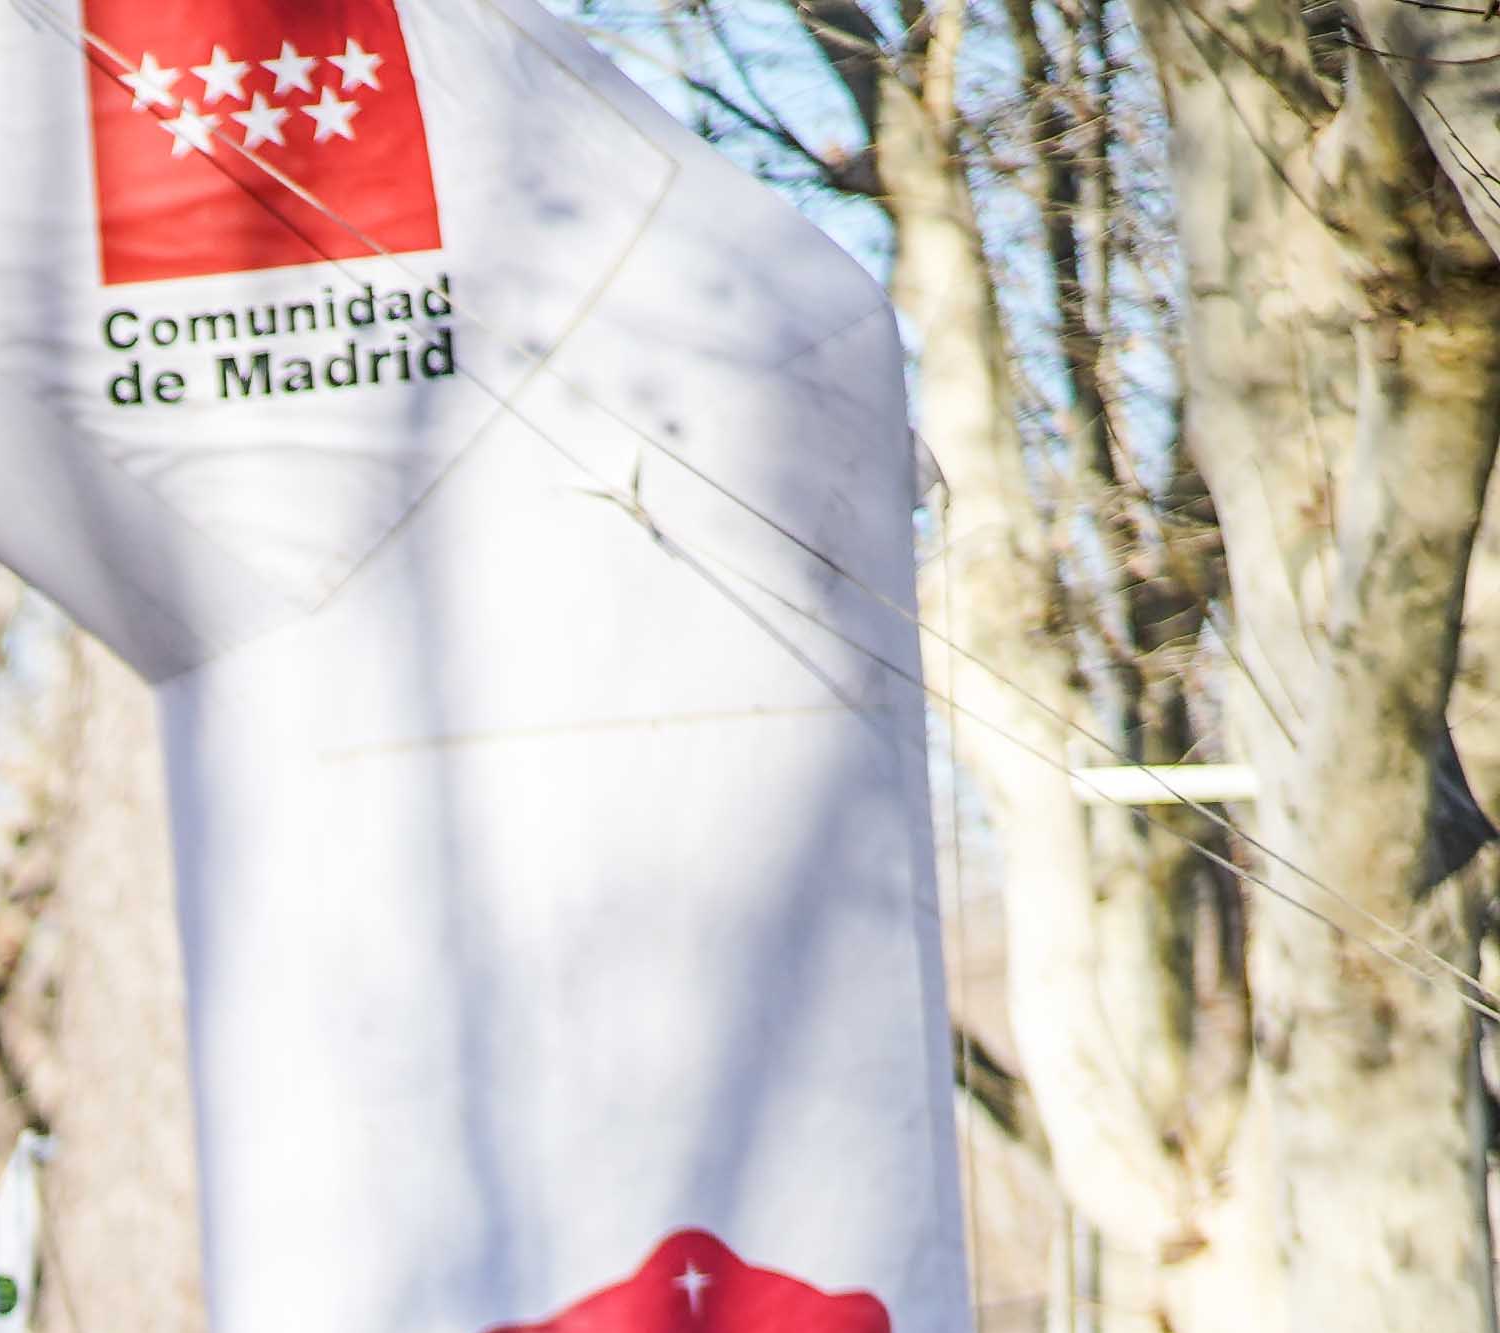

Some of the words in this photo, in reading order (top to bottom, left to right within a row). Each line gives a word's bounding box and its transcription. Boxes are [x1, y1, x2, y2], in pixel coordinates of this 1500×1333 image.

[103, 273, 452, 349] Comunidad
[109, 361, 186, 405] de
[217, 329, 455, 399] Madrid
